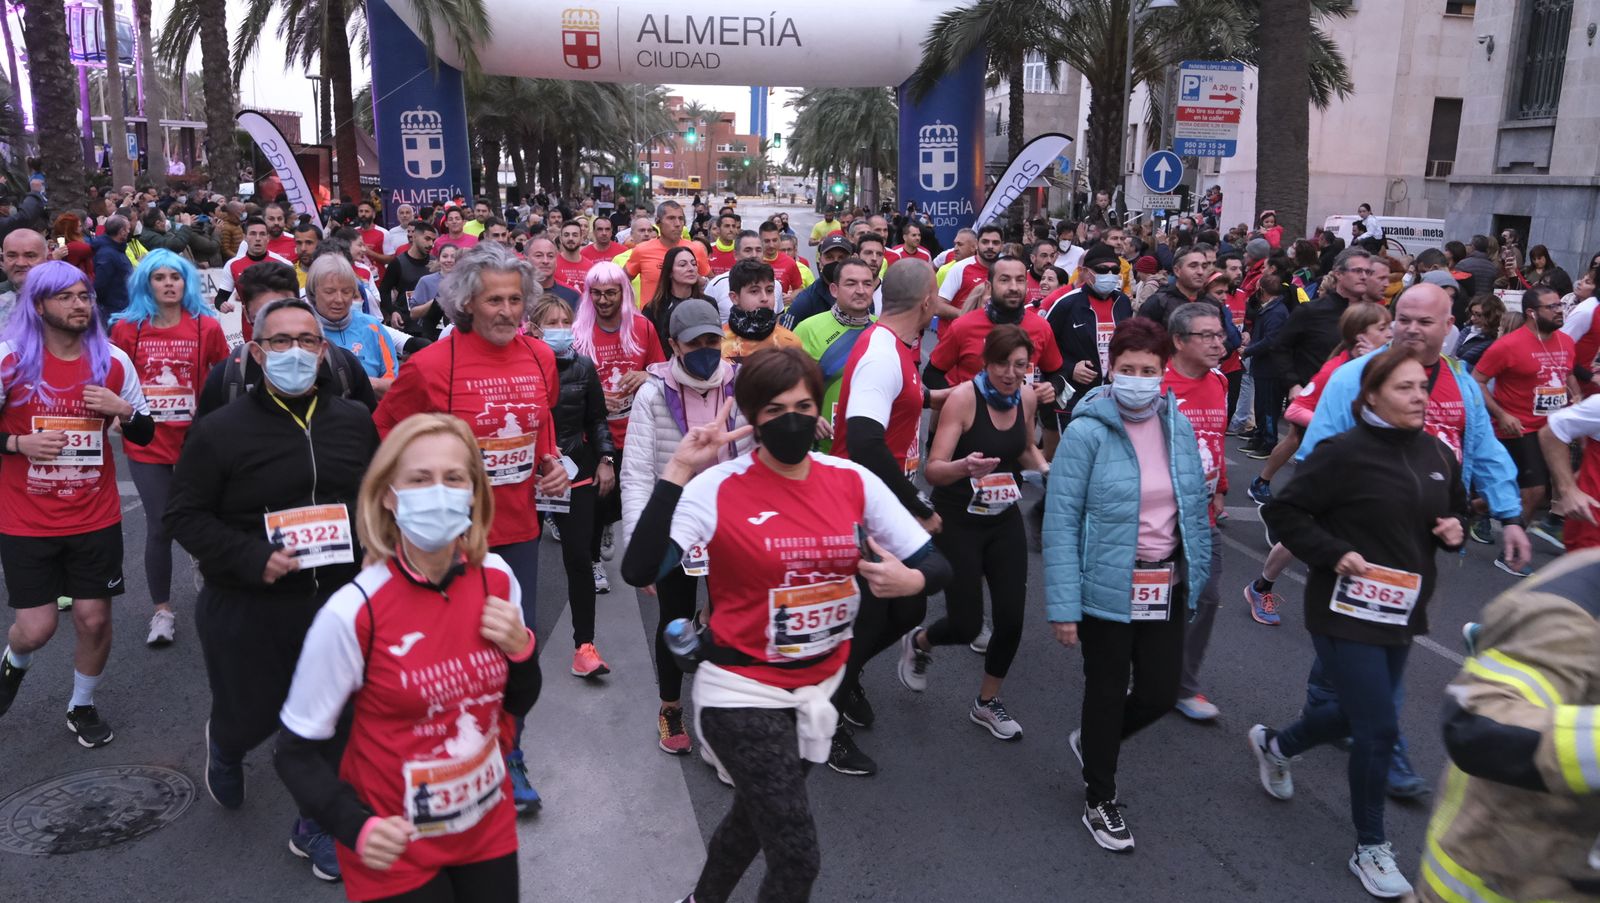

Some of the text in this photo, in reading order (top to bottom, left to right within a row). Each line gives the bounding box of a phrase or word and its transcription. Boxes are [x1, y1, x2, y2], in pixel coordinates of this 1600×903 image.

[636, 11, 802, 47] ALMERÍA
[636, 50, 721, 69] CIUDAD
[1183, 76, 1199, 95] P
[150, 397, 186, 409] 3274
[487, 450, 528, 468] 3450
[984, 488, 1016, 501] 3134
[286, 525, 339, 547] 3322
[1351, 581, 1405, 606] 3362
[790, 603, 849, 632] 3576
